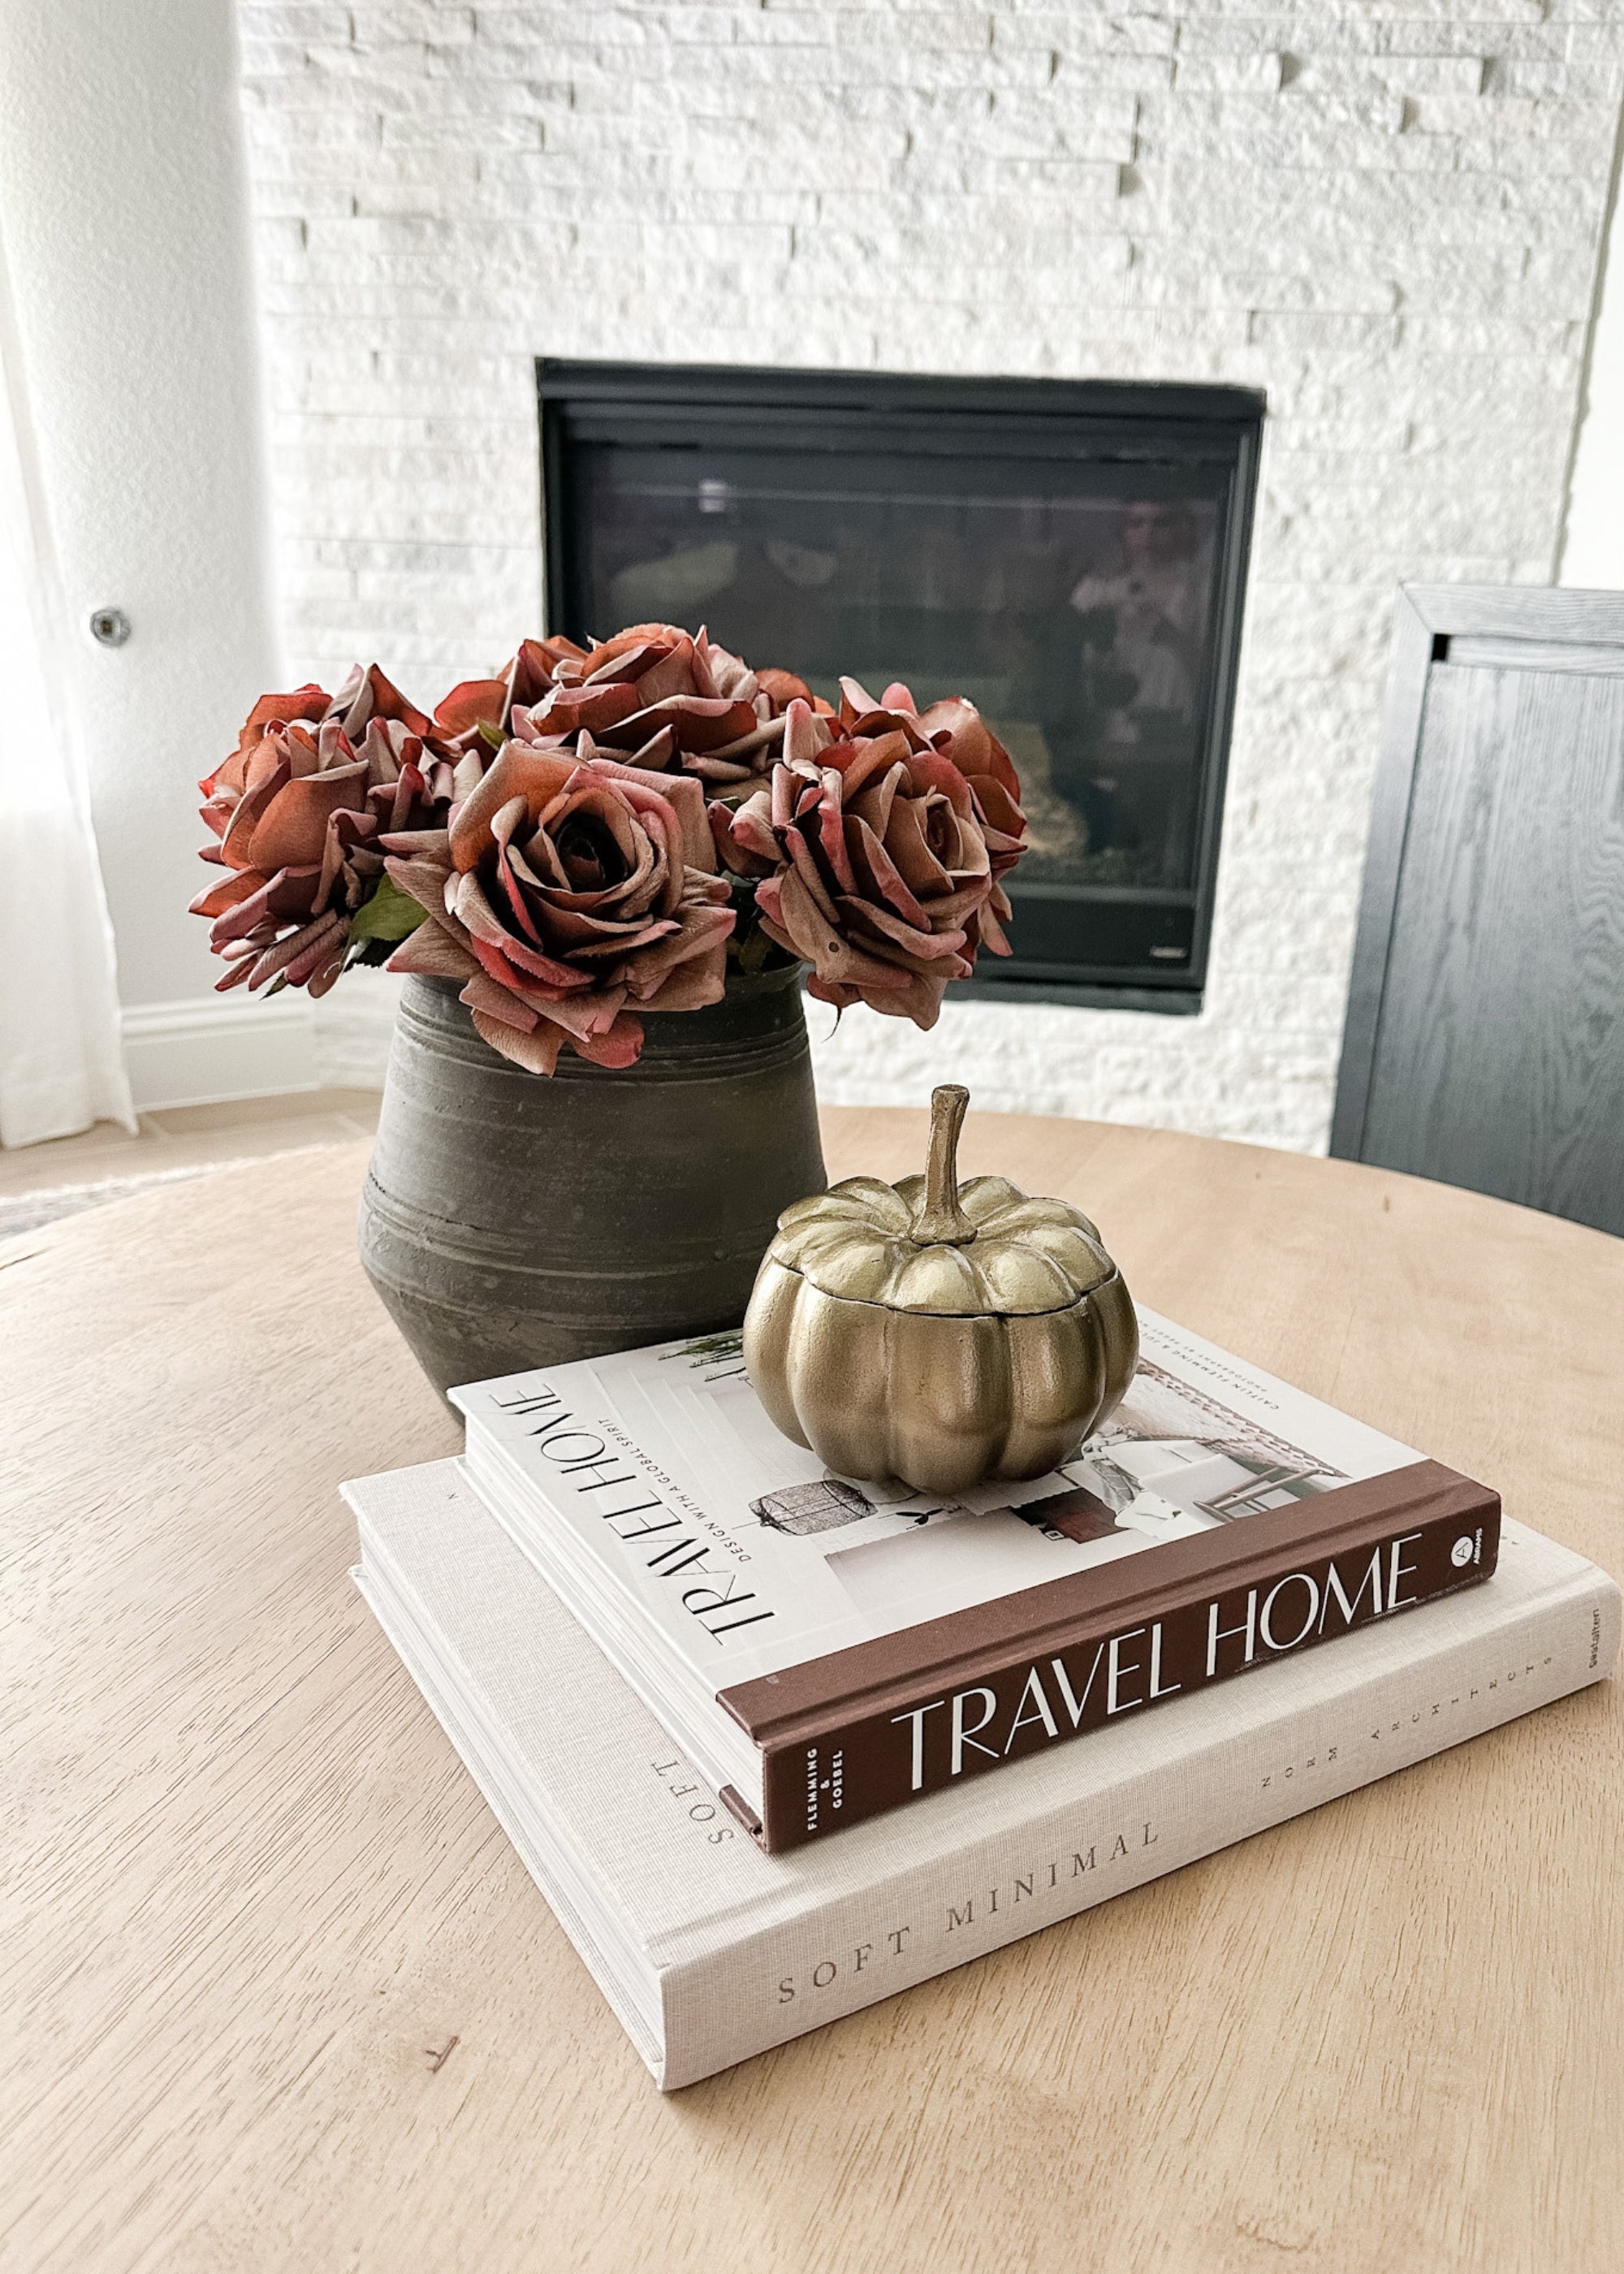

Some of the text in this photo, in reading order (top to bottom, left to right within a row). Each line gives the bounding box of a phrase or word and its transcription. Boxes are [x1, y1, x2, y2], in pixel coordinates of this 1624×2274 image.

[1172, 1350, 1229, 1382] FLEMMING
[1232, 1382, 1279, 1410] CAITLIN
[489, 1383, 775, 1646] TRAVEL HOME
[598, 1418, 752, 1563] DESIGN WITH A GLOBAL SPIRIT
[891, 1533, 1423, 1791] TRAVEL HOME
[1261, 1655, 1553, 1788] NORM ARCHITECTS
[650, 1760, 734, 1844] SOFT
[807, 1748, 818, 1831] FLEMMING
[820, 1779, 829, 1790] &
[832, 1750, 843, 1809] GOEBEL
[777, 1822, 1159, 2004] SOFT MINIMAL
